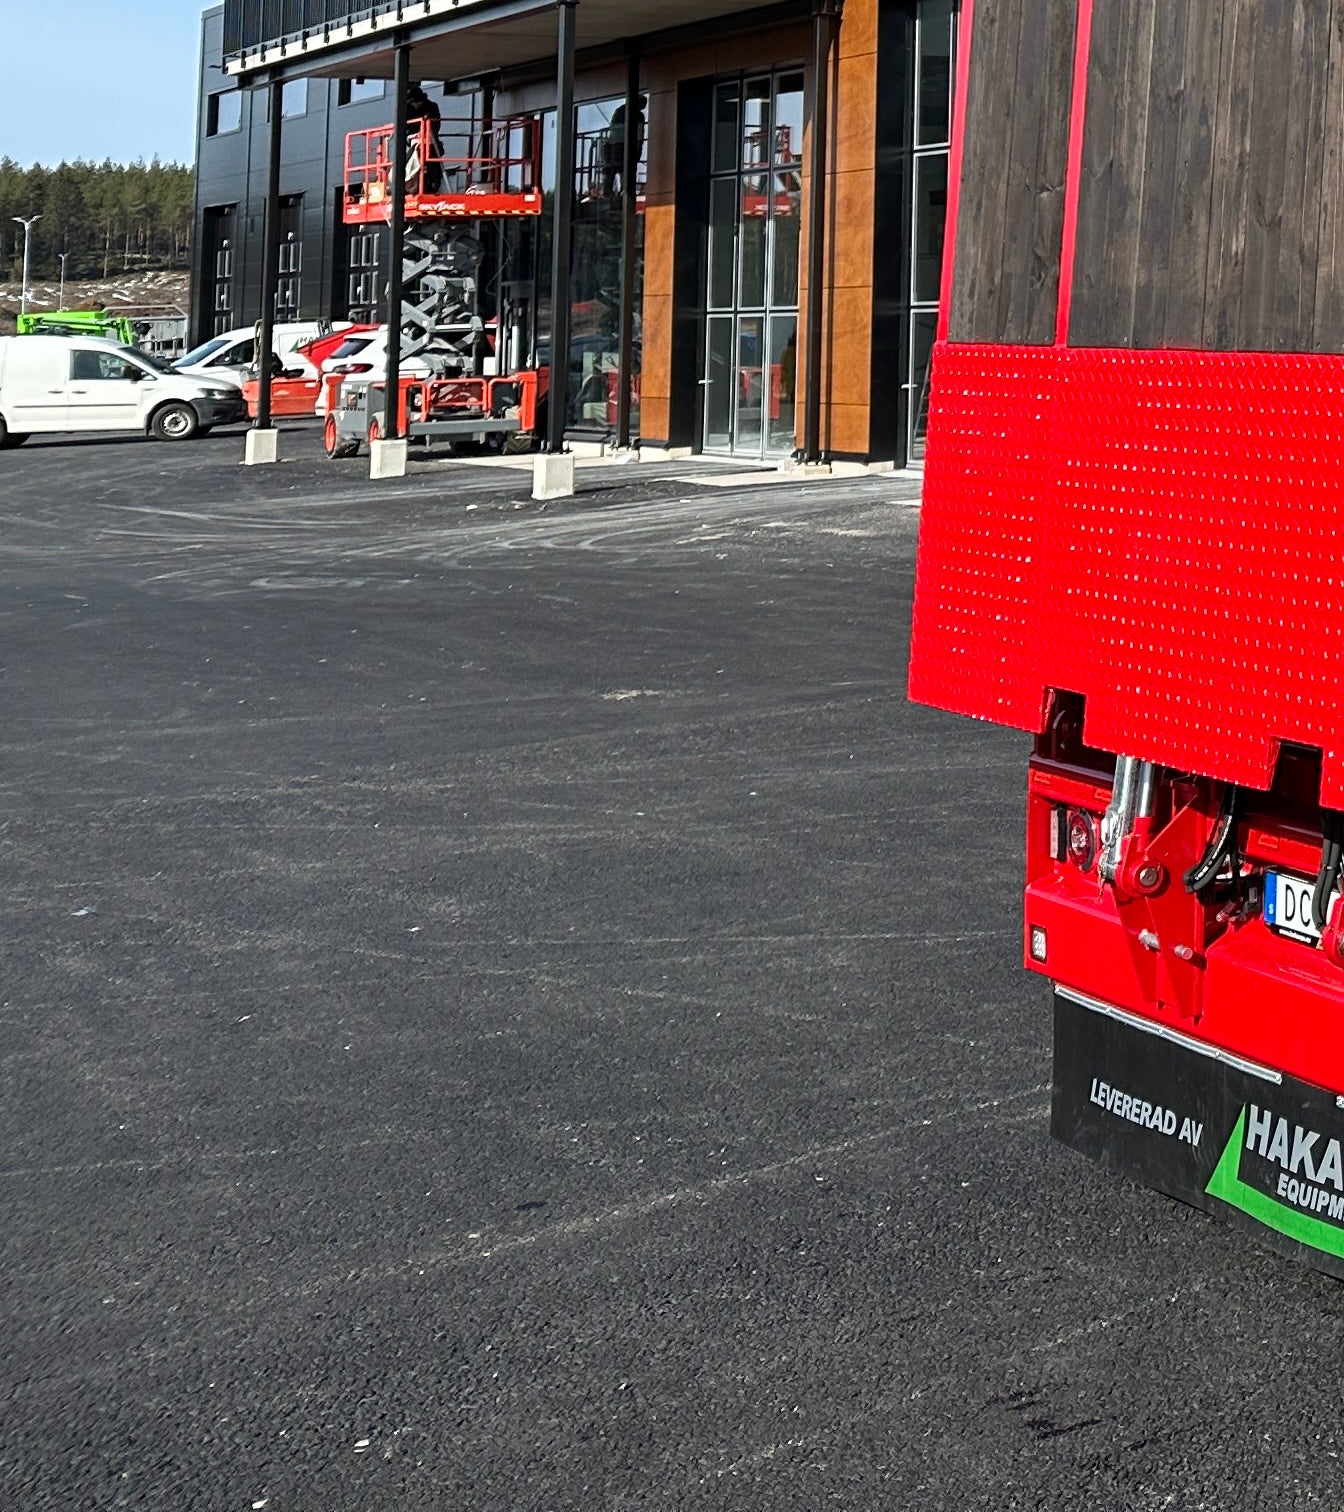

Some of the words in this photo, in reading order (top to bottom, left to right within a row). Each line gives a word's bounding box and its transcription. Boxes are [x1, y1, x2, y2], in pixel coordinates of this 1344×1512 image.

[1285, 884, 1311, 927] DC
[1090, 1078, 1177, 1136] LEVERERAD
[1179, 1117, 1203, 1147] AV
